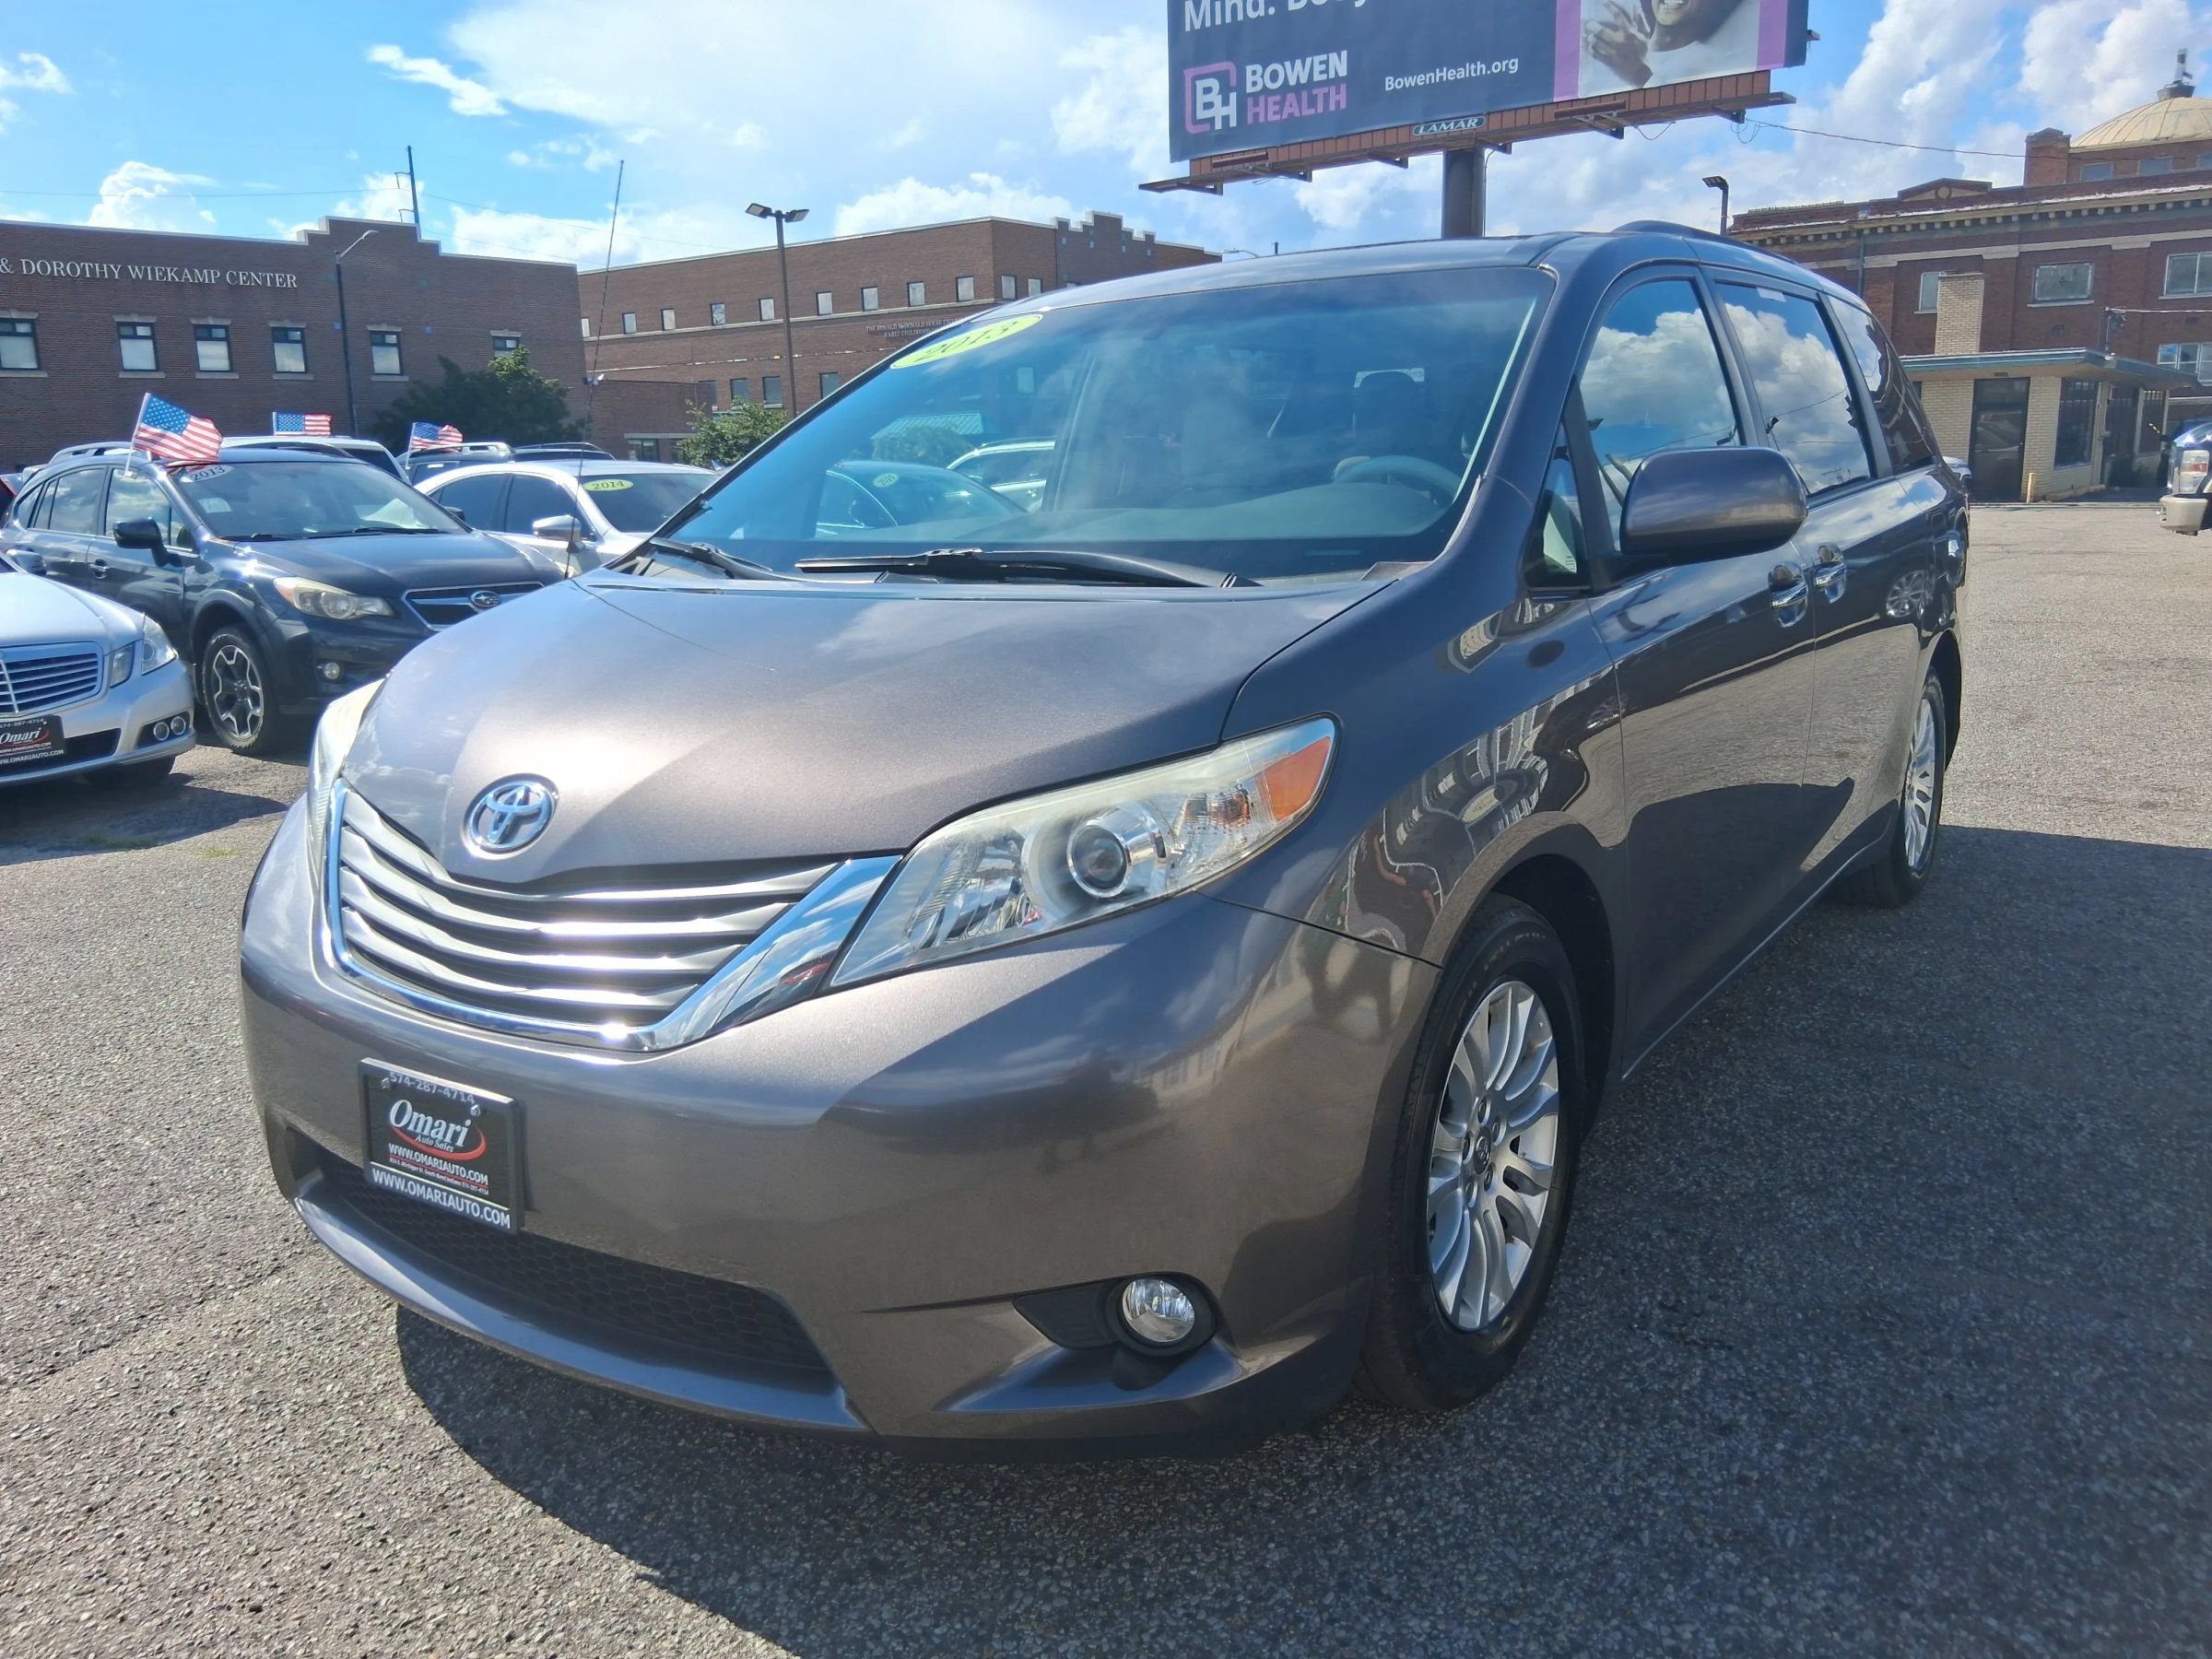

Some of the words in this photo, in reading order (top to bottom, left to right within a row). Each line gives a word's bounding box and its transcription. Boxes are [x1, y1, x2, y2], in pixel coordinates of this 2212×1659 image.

[1245, 50, 1347, 93] BOWEN
[1384, 58, 1519, 91] BowenHealth.org
[1247, 83, 1347, 125] HEALTH
[1418, 118, 1478, 135] LAMAR
[0, 257, 15, 274] &
[20, 258, 122, 279] DOROTHY
[127, 265, 220, 284] WIEKAMP
[226, 270, 299, 288] CENTER
[913, 322, 1018, 362] 2013
[191, 466, 226, 480] 2013
[592, 481, 624, 489] 2014
[0, 727, 41, 744] Omari
[390, 1071, 476, 1104] 574-287-4714
[389, 1099, 472, 1147] Omari
[415, 1135, 433, 1146] Auto
[434, 1138, 454, 1152] Sales
[388, 1143, 488, 1185] WWW.OMARIAUTO.COM
[371, 1168, 511, 1230] WWW.OMARIAUTO.COM
